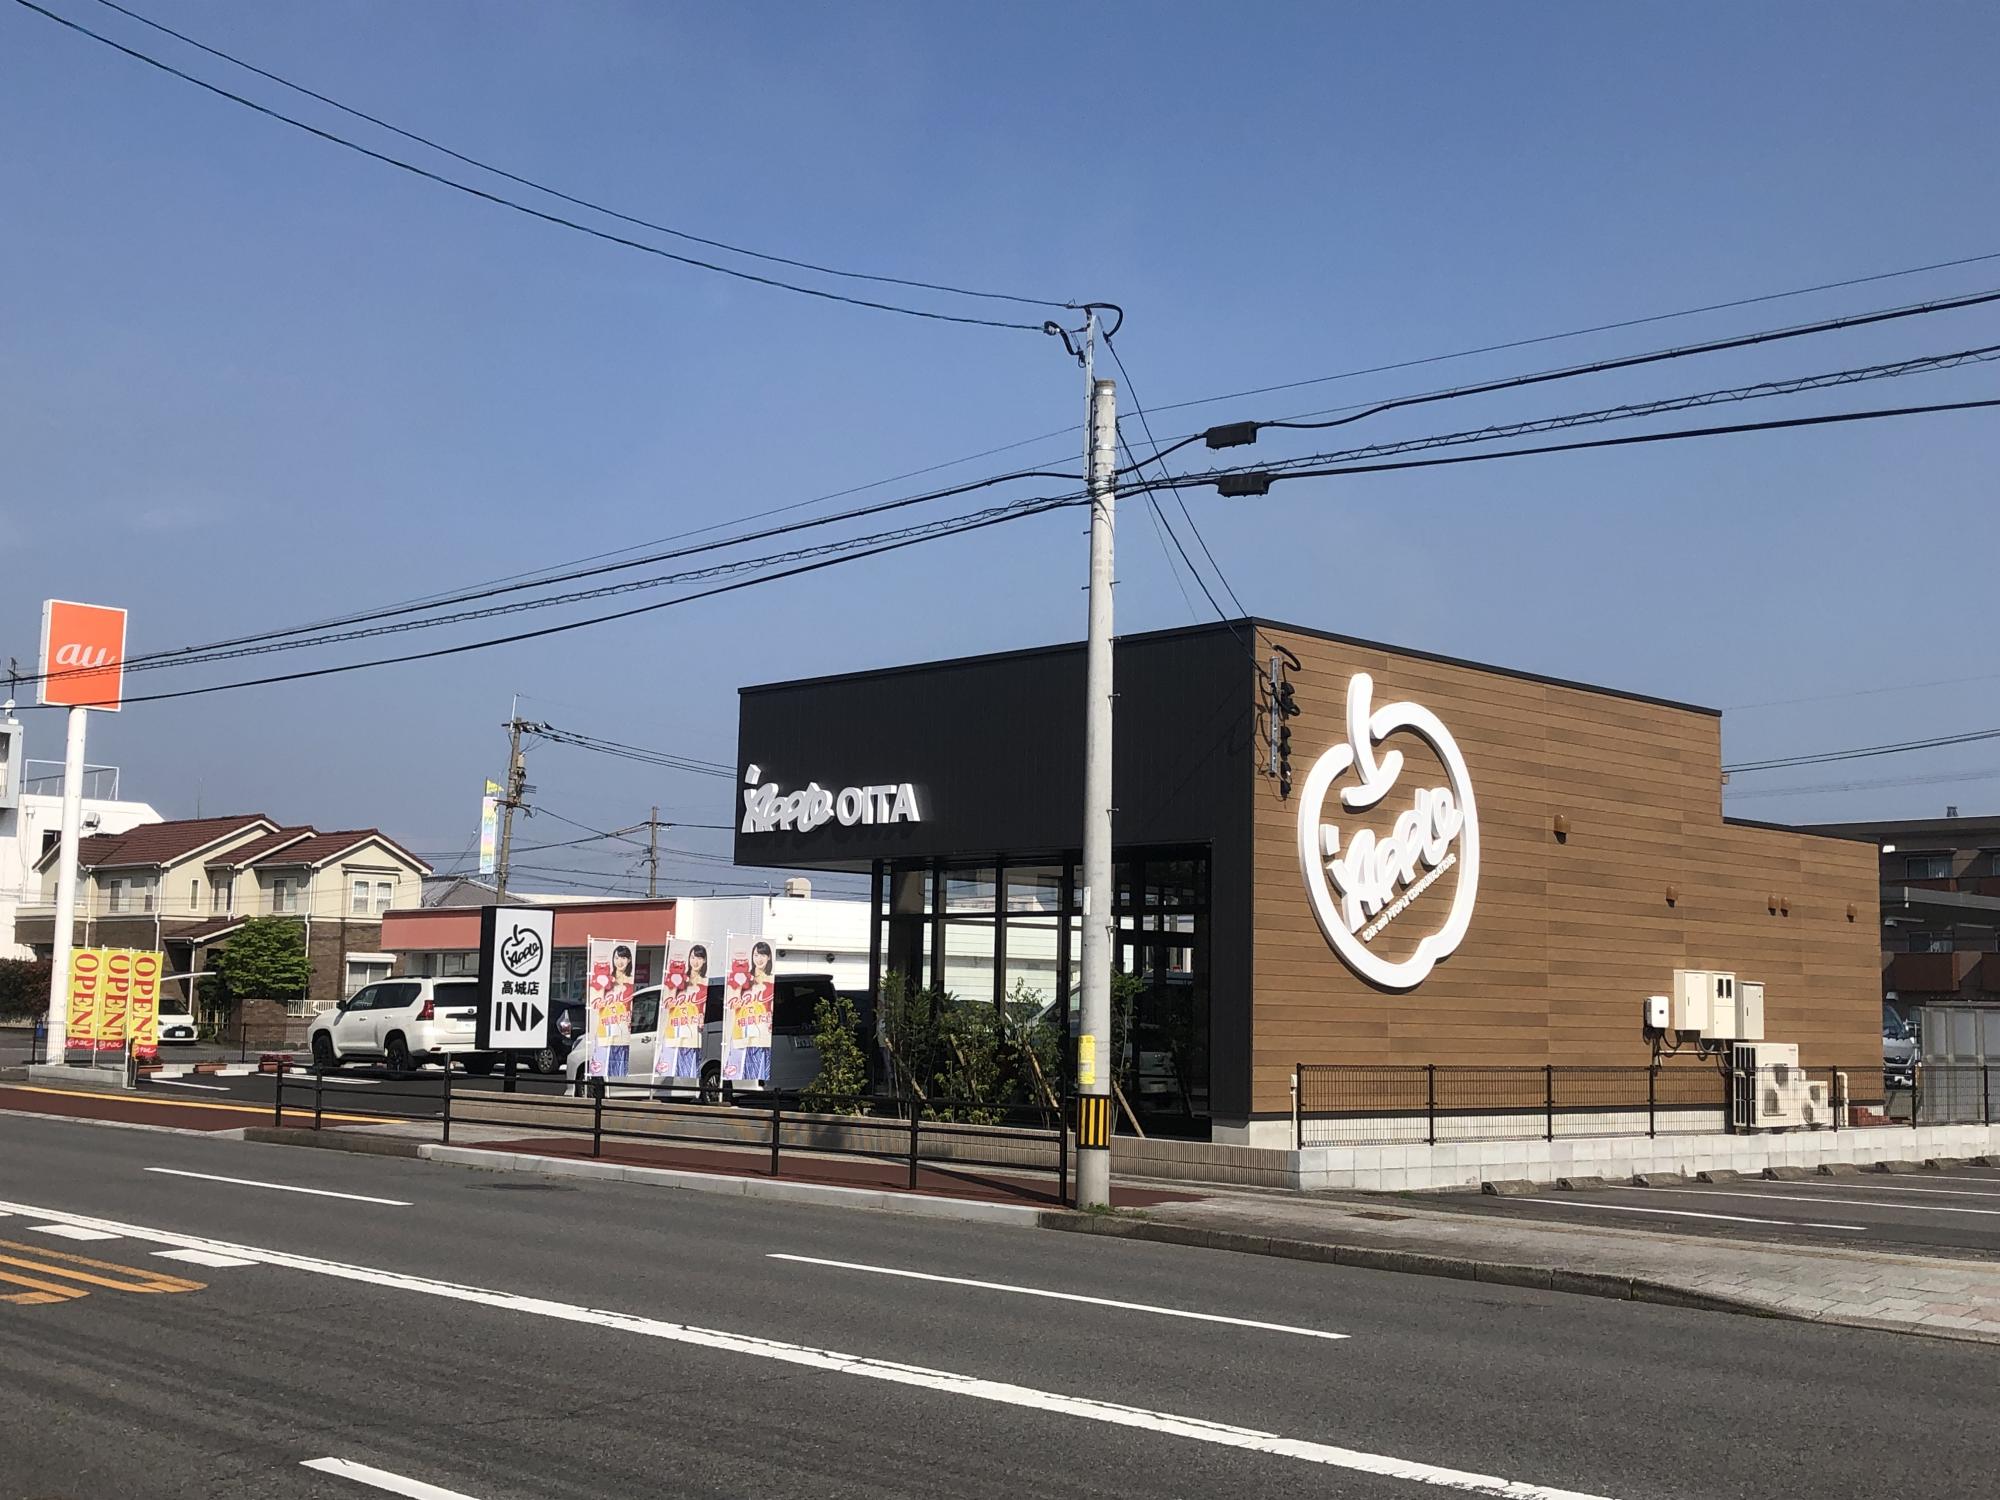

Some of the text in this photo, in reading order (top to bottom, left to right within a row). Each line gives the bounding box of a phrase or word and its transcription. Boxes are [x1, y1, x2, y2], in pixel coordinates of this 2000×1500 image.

[56, 643, 116, 668] au
[836, 783, 921, 827] OITA
[501, 980, 540, 995] 高城店
[495, 1001, 528, 1031] IN
